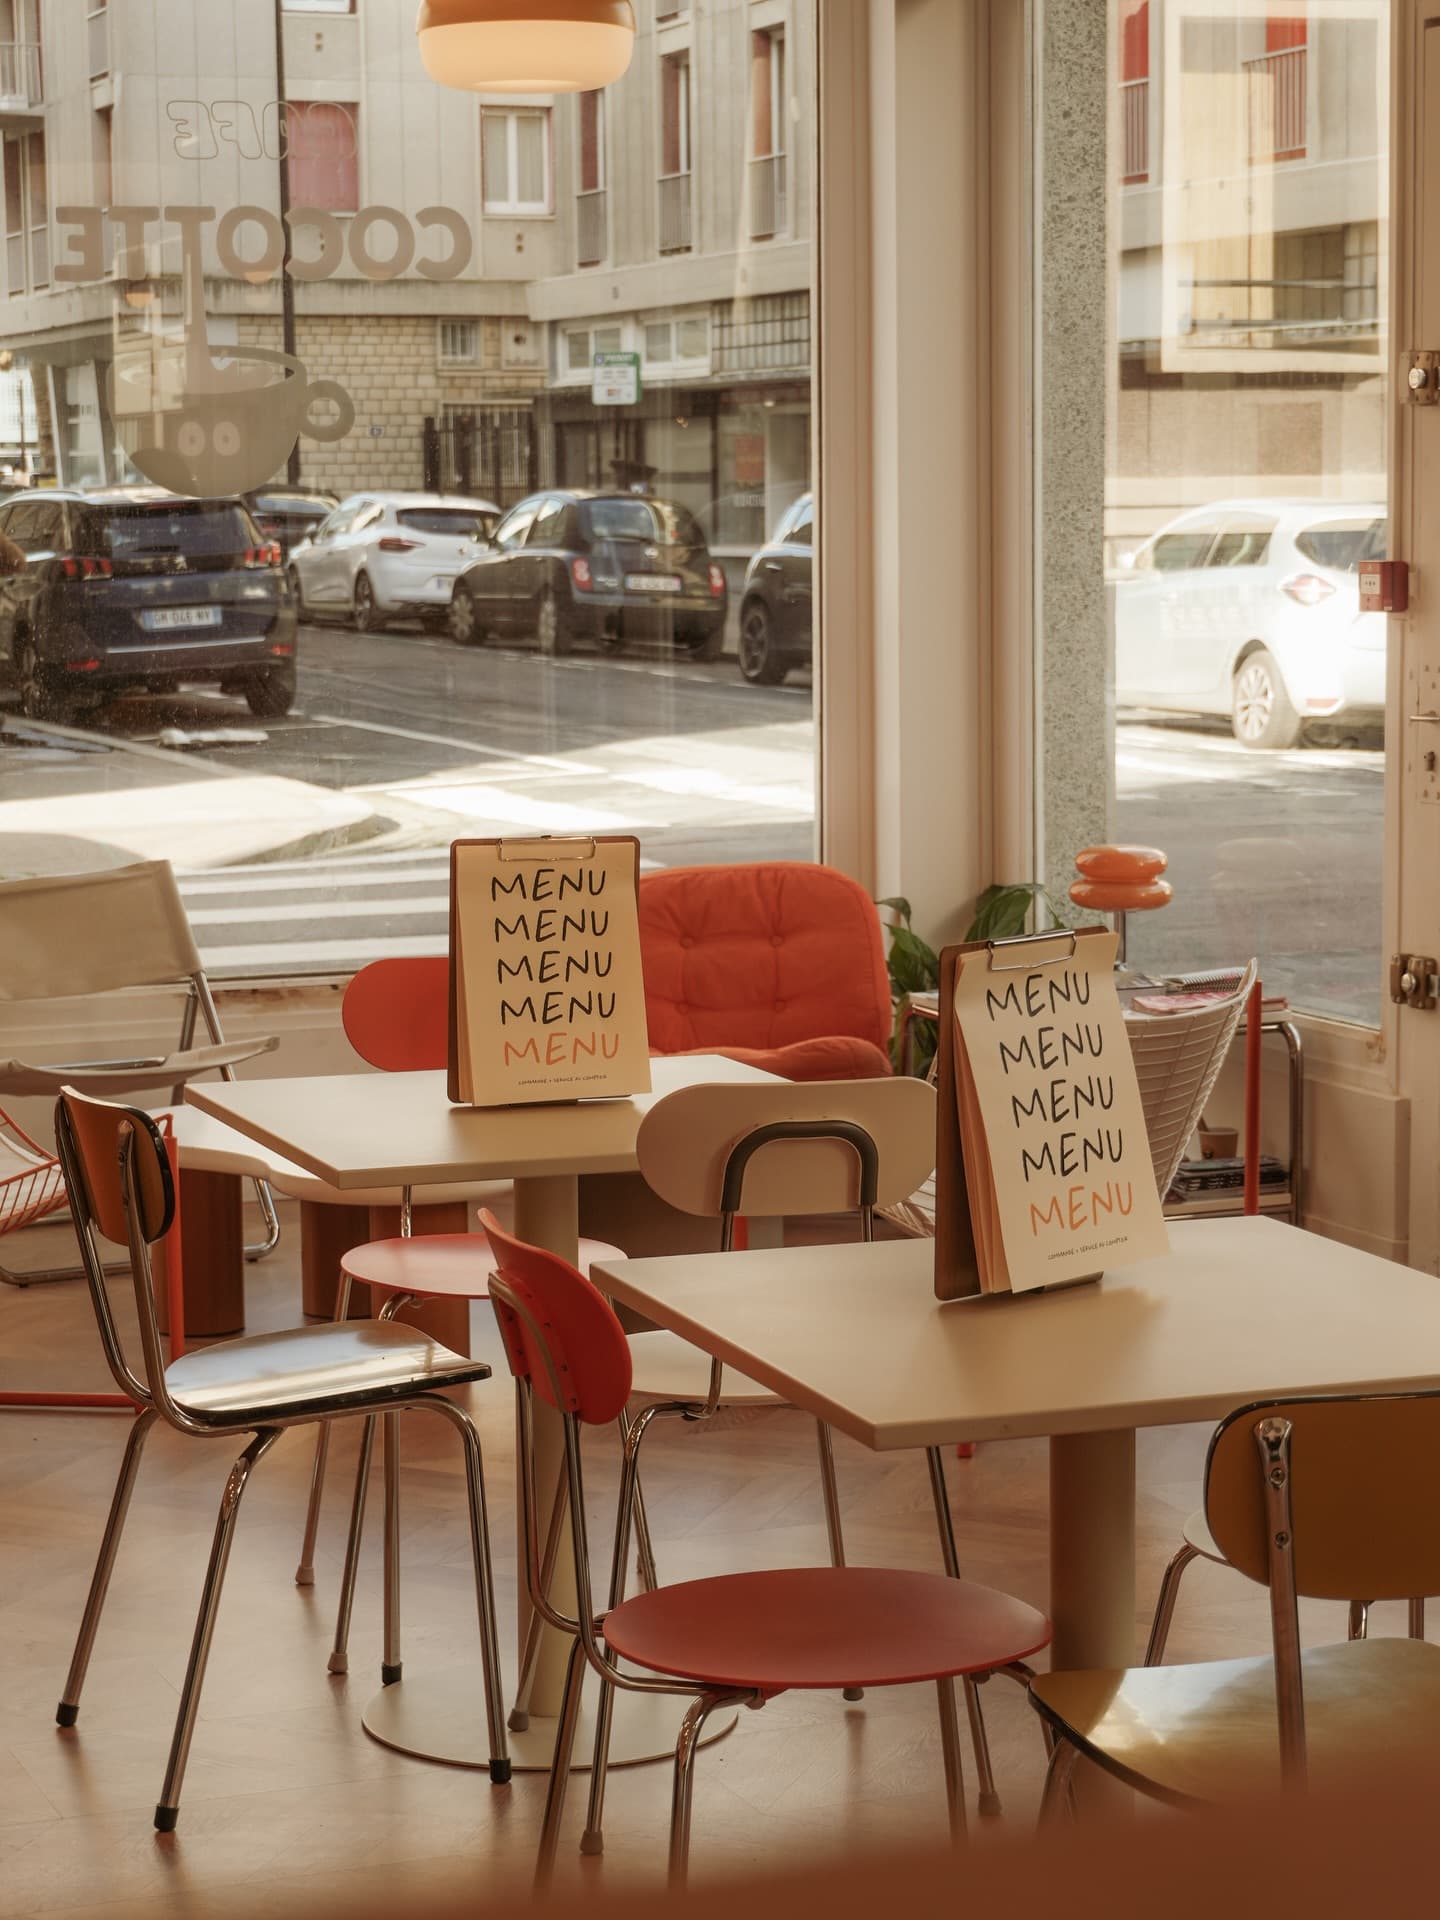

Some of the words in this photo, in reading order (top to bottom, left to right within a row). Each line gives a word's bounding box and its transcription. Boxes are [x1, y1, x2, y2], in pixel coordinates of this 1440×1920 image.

[492, 869, 605, 901] MENU
[495, 909, 608, 942] MENU
[498, 950, 611, 984] MENU
[501, 991, 615, 1024] MENU
[987, 971, 1090, 1021] MENU
[504, 1032, 619, 1066] MENU
[1000, 1024, 1103, 1074] MENU
[1012, 1076, 1114, 1128] MENU
[1022, 1129, 1123, 1182] MENU
[1030, 1182, 1133, 1236] MENU
[1079, 1243, 1098, 1253] SERVICE
